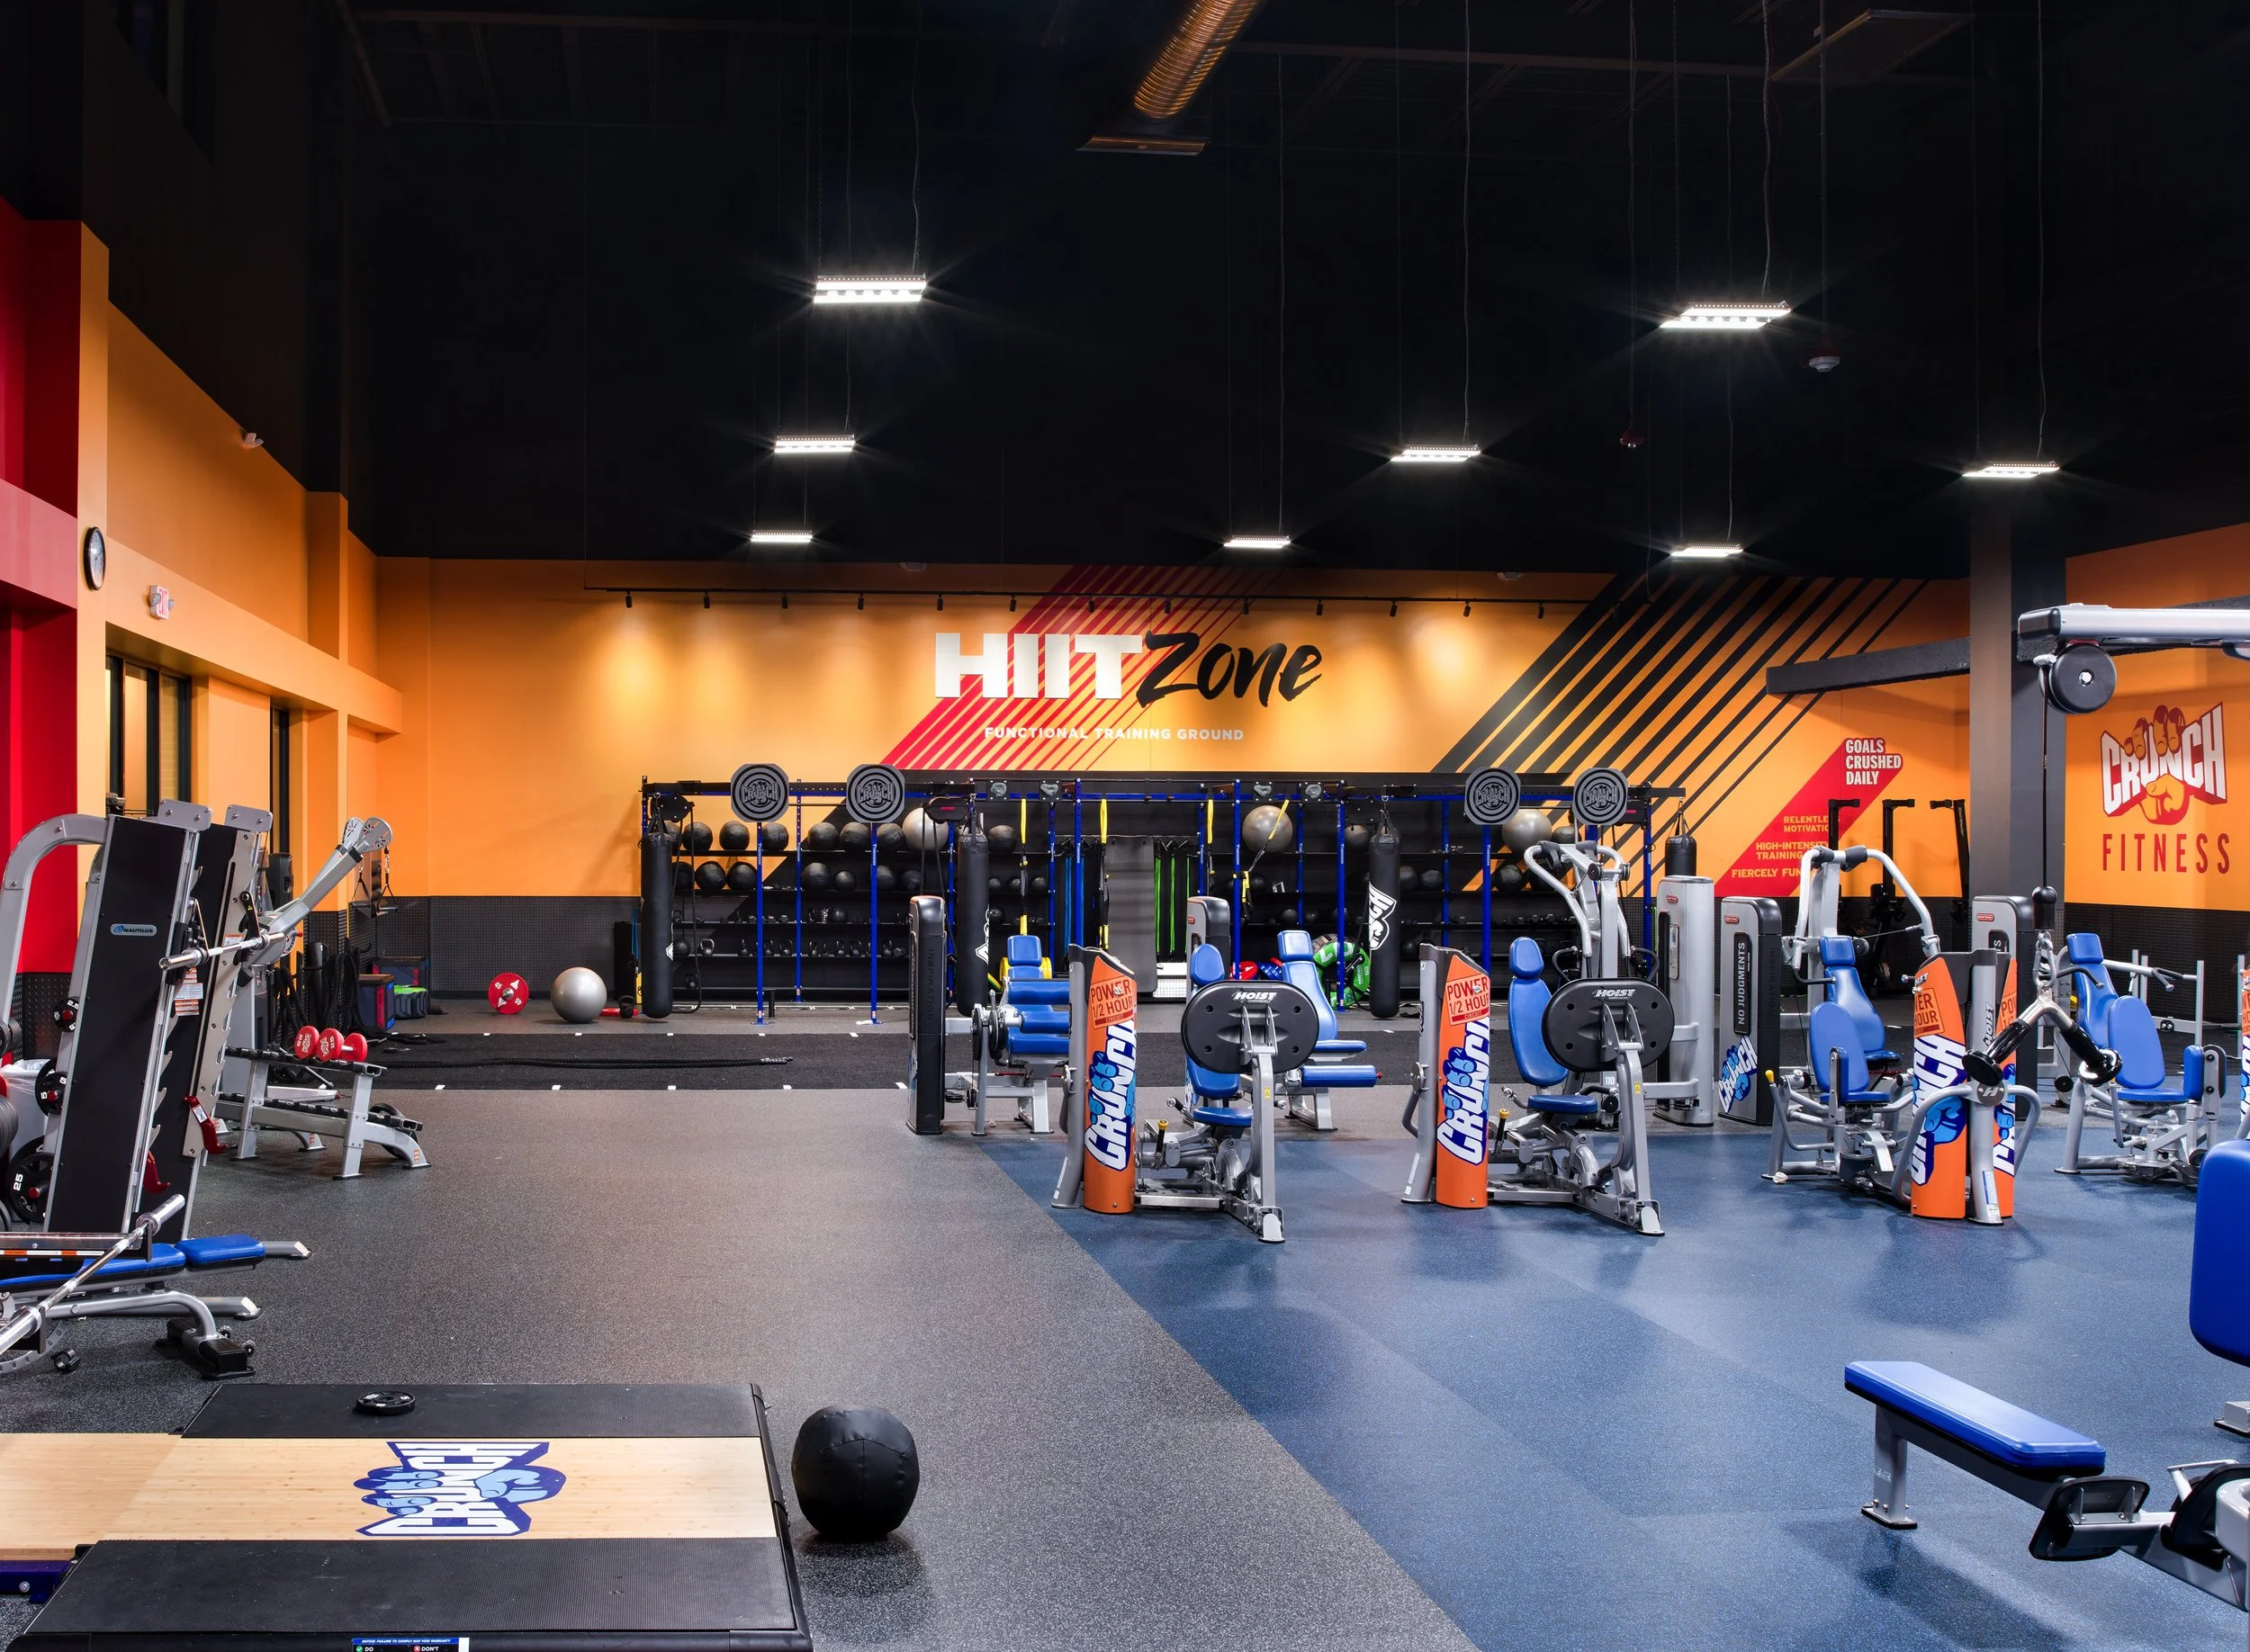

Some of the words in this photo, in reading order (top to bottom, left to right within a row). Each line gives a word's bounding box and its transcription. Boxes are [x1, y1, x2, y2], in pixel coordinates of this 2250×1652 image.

[935, 633, 1143, 699] HIIT
[1136, 629, 1323, 708] Zone
[984, 727, 1089, 740] FUNCTIONAL
[1094, 727, 1172, 741] TRAINING
[1177, 728, 1244, 741] GROUND
[1845, 739, 1885, 754] GOALS
[1845, 754, 1902, 769] CRUSHED
[2101, 702, 2228, 816] CRUNCH
[1846, 770, 1879, 786] DAILY
[742, 781, 779, 804] CRUNCH
[856, 781, 895, 804] CRUNCH
[1474, 784, 1510, 807] CRUNCH
[1582, 785, 1618, 807] CRUNCH
[1784, 815, 1829, 824] RELENTLE
[1756, 851, 1803, 860] TRAINING
[2102, 832, 2230, 874] FITNESS
[1732, 869, 1777, 878] FIERCELY
[1090, 979, 1131, 1003] POWER
[1234, 992, 1278, 1001] HOIST
[1447, 976, 1489, 1001] POWER
[1595, 989, 1636, 997] HOIST
[1093, 1003, 1104, 1019] 1/2
[1105, 996, 1133, 1014] HOUR
[1449, 1001, 1463, 1015] 1/2
[1738, 1009, 1745, 1025] NO
[13, 1173, 23, 1191] 25
[356, 1441, 549, 1536] CRUNCH
